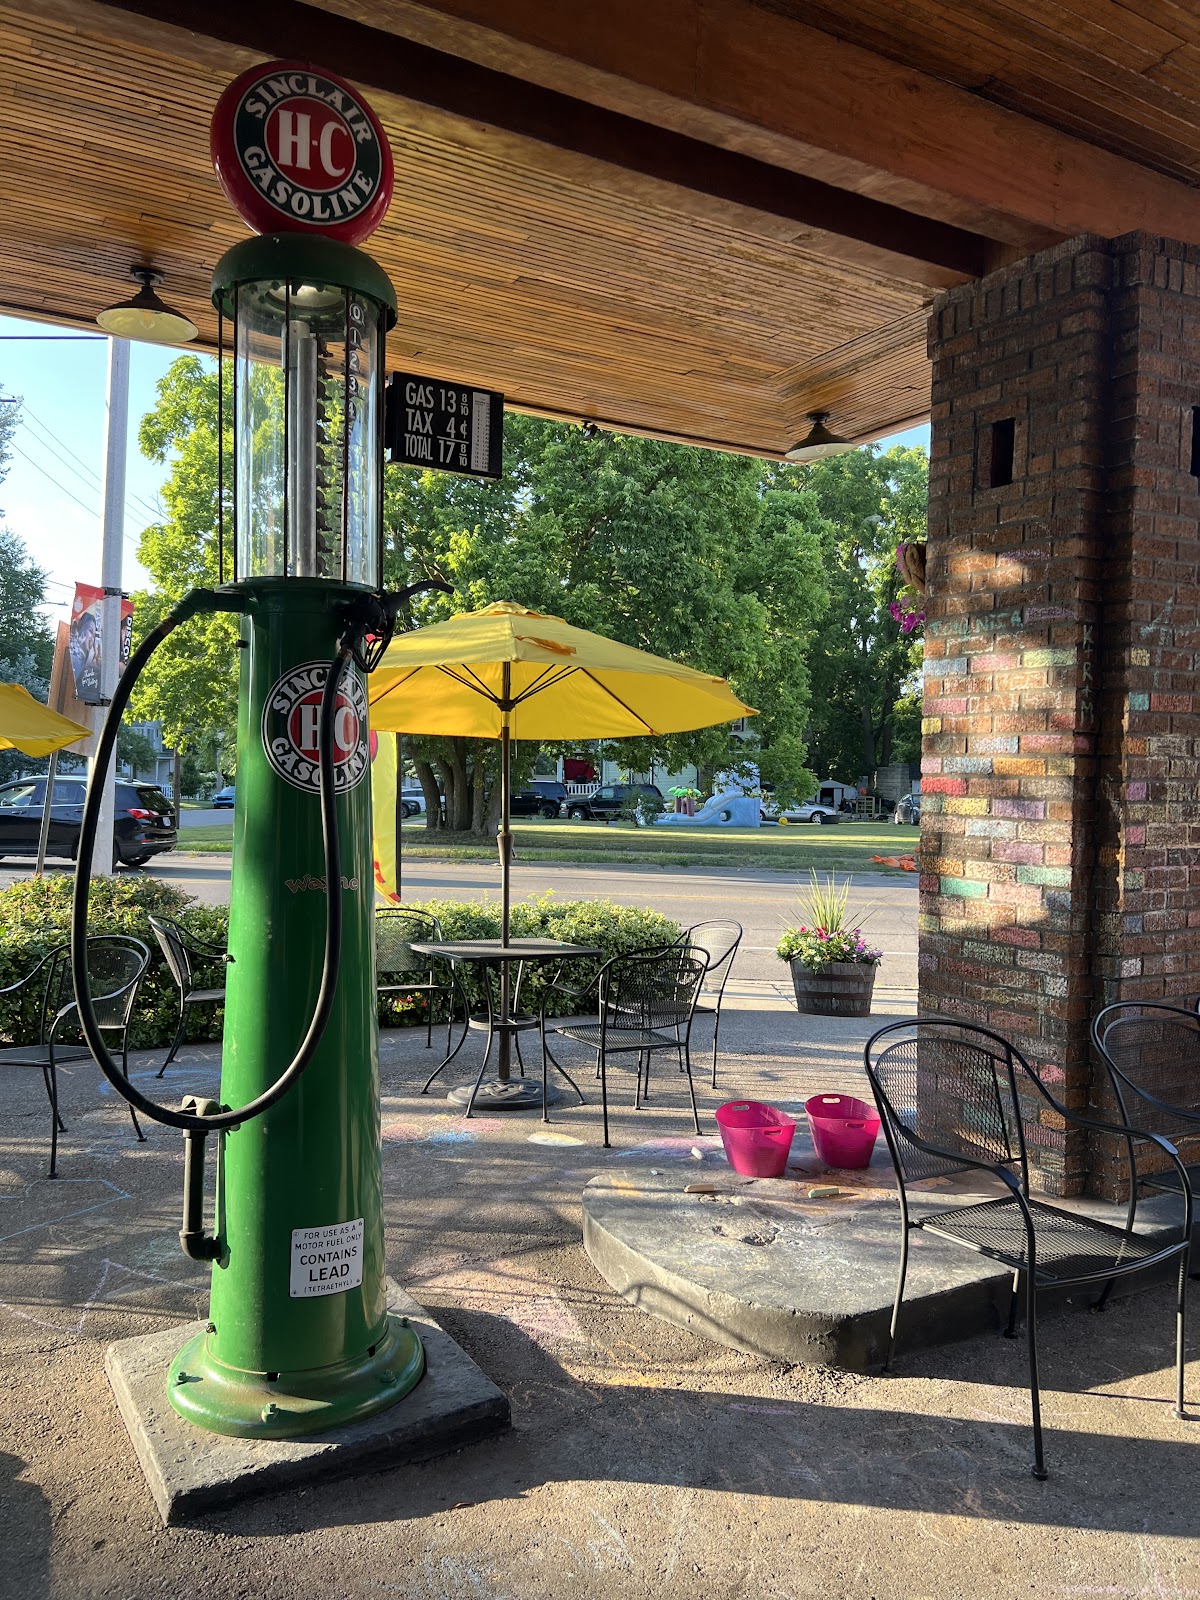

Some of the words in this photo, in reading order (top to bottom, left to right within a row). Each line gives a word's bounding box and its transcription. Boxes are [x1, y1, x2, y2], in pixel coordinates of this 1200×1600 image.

[245, 74, 372, 144] SINCLAIR
[243, 146, 374, 219] GASOLINE
[405, 382, 435, 409] GAS
[440, 389, 457, 413] 13
[405, 408, 433, 435] TAX
[446, 417, 456, 439] 4
[404, 433, 434, 460] TOTAL
[438, 440, 456, 464] 17
[123, 616, 132, 662] DISCO
[272, 668, 367, 721] SINCAIR
[294, 1241, 324, 1250] MOTOR
[326, 1238, 344, 1247] FUEL
[346, 1233, 362, 1243] ONLY
[304, 1231, 320, 1240] FOR
[322, 1229, 338, 1238] USE
[340, 1226, 349, 1235] AS
[351, 1224, 356, 1232] A
[300, 1246, 357, 1265] CONTAINS
[304, 1279, 353, 1294] (TETRAETHYL)
[309, 1263, 350, 1282] LEAD
